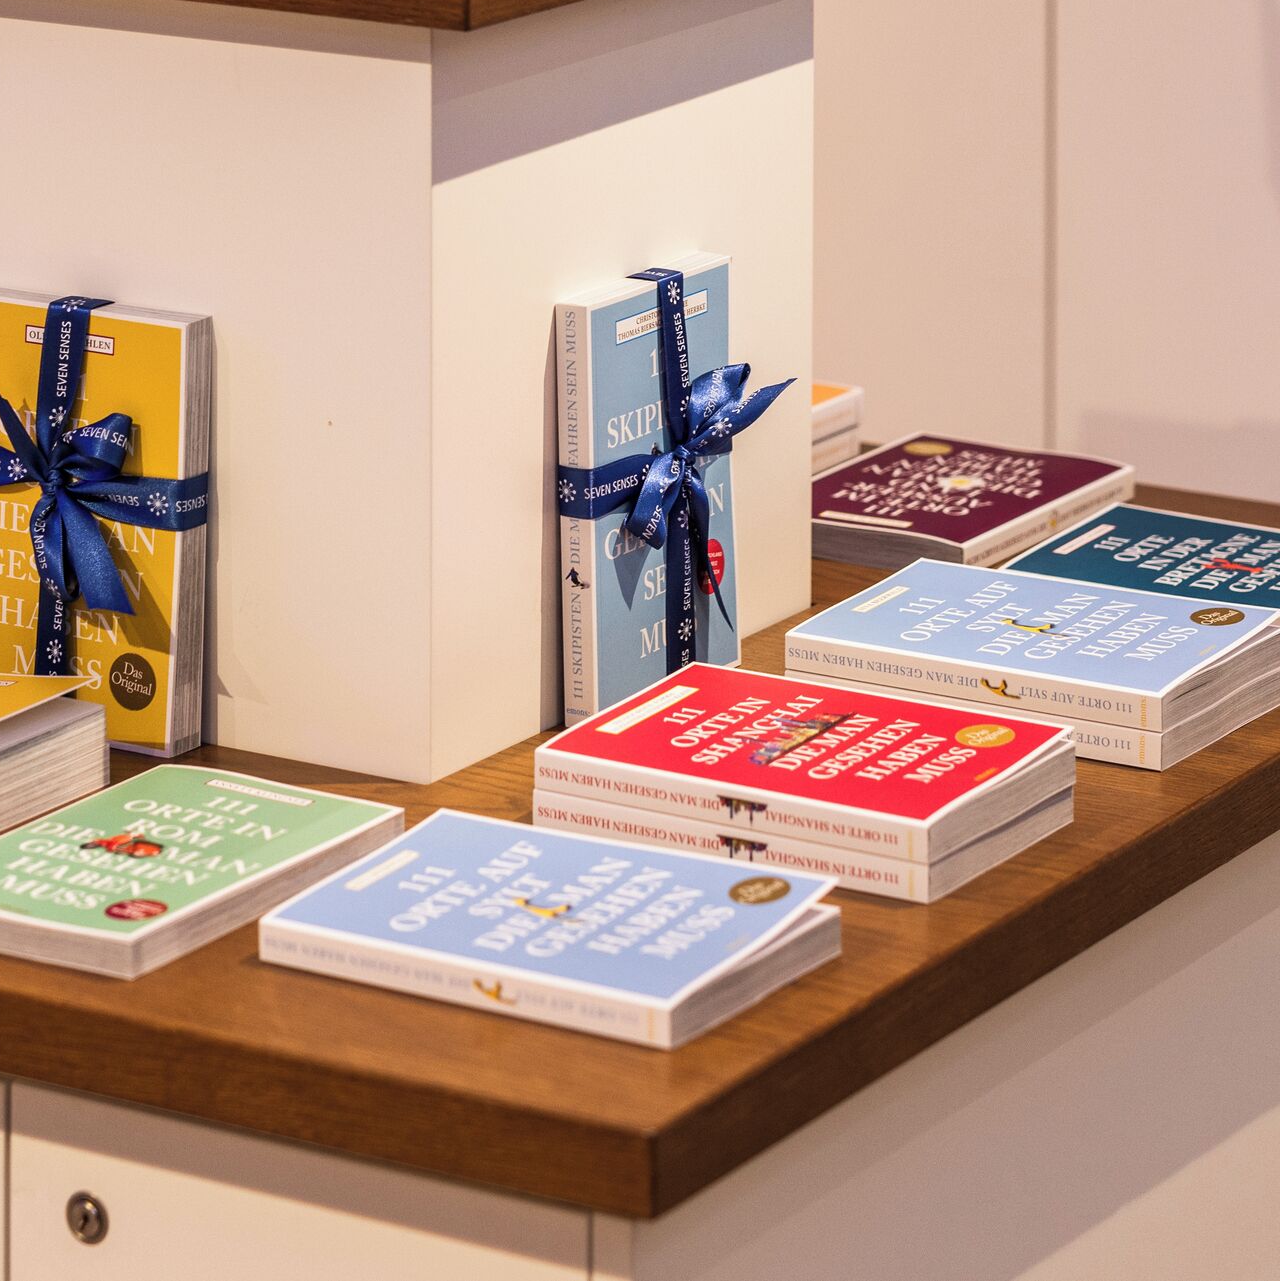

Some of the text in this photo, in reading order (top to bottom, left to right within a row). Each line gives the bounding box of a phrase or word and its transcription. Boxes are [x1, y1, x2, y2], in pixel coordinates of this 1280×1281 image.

[618, 302, 706, 341] THOMAS HERBKE
[56, 320, 72, 398] SEVEN SENSES
[673, 312, 690, 388] SEVEN SENSES
[80, 426, 109, 441] SEVEN
[607, 401, 664, 449] SKIPI
[176, 496, 206, 513] SENSES
[565, 311, 583, 699] 111 SKIPISTEN DIE FAHREN SEIN MUSS
[584, 474, 639, 500] SEVEN SENSES
[642, 505, 663, 539] SEVEN
[1093, 535, 1131, 551] 111
[34, 533, 48, 570] SEVEN
[1113, 533, 1176, 562] ORTE
[1137, 536, 1215, 572] IN DER
[643, 564, 666, 601] SE
[682, 581, 691, 611] SEVEN
[1188, 566, 1239, 592] DIE
[898, 597, 948, 617] 111
[900, 579, 1020, 643] ORTE AUF
[966, 602, 1034, 633] SYLT
[976, 591, 1103, 657] DIE MAN
[1200, 609, 1237, 627] Original
[1201, 608, 1222, 620] Das
[1024, 600, 1141, 661] GESEHEN
[1075, 612, 1169, 659] HABEN
[1123, 623, 1201, 662] MUSS
[111, 671, 153, 695] Original
[123, 661, 143, 679] Das
[788, 647, 1133, 713] 111 ORTE AUF SYLT DIE MAN GESEHEN HABEN MUSS
[663, 706, 707, 725] 111
[669, 708, 741, 749] ORTE
[730, 695, 773, 720] IN
[690, 694, 824, 766] SHANGHAI
[966, 728, 987, 740] Das
[768, 711, 881, 773] DIE MAN
[807, 717, 922, 780] GESEHEN
[854, 732, 949, 781] HABEN
[1076, 732, 1131, 751] 111 ORTE
[902, 745, 978, 784] MUSS
[123, 799, 288, 841] ORTE IN
[204, 795, 259, 816] 111
[539, 766, 899, 845] 111 ORTE IN SHANGHAI DIE MAN GESEHEN HABEN MUSS
[19, 839, 213, 886] GESEHEN
[28, 820, 261, 876] DIE MAN
[537, 805, 899, 885] 111 ORTE IN SHANGHAI DIE MAN GESEHEN HABEN MUSS
[5, 855, 158, 897] HABEN
[389, 838, 544, 932] ORTE AUF
[398, 865, 455, 893] 111
[468, 872, 555, 918] SYLT
[472, 856, 634, 951] DIE MAN
[524, 866, 674, 958] GESEHEN
[586, 884, 705, 955] HABEN
[641, 904, 737, 960] MUSS
